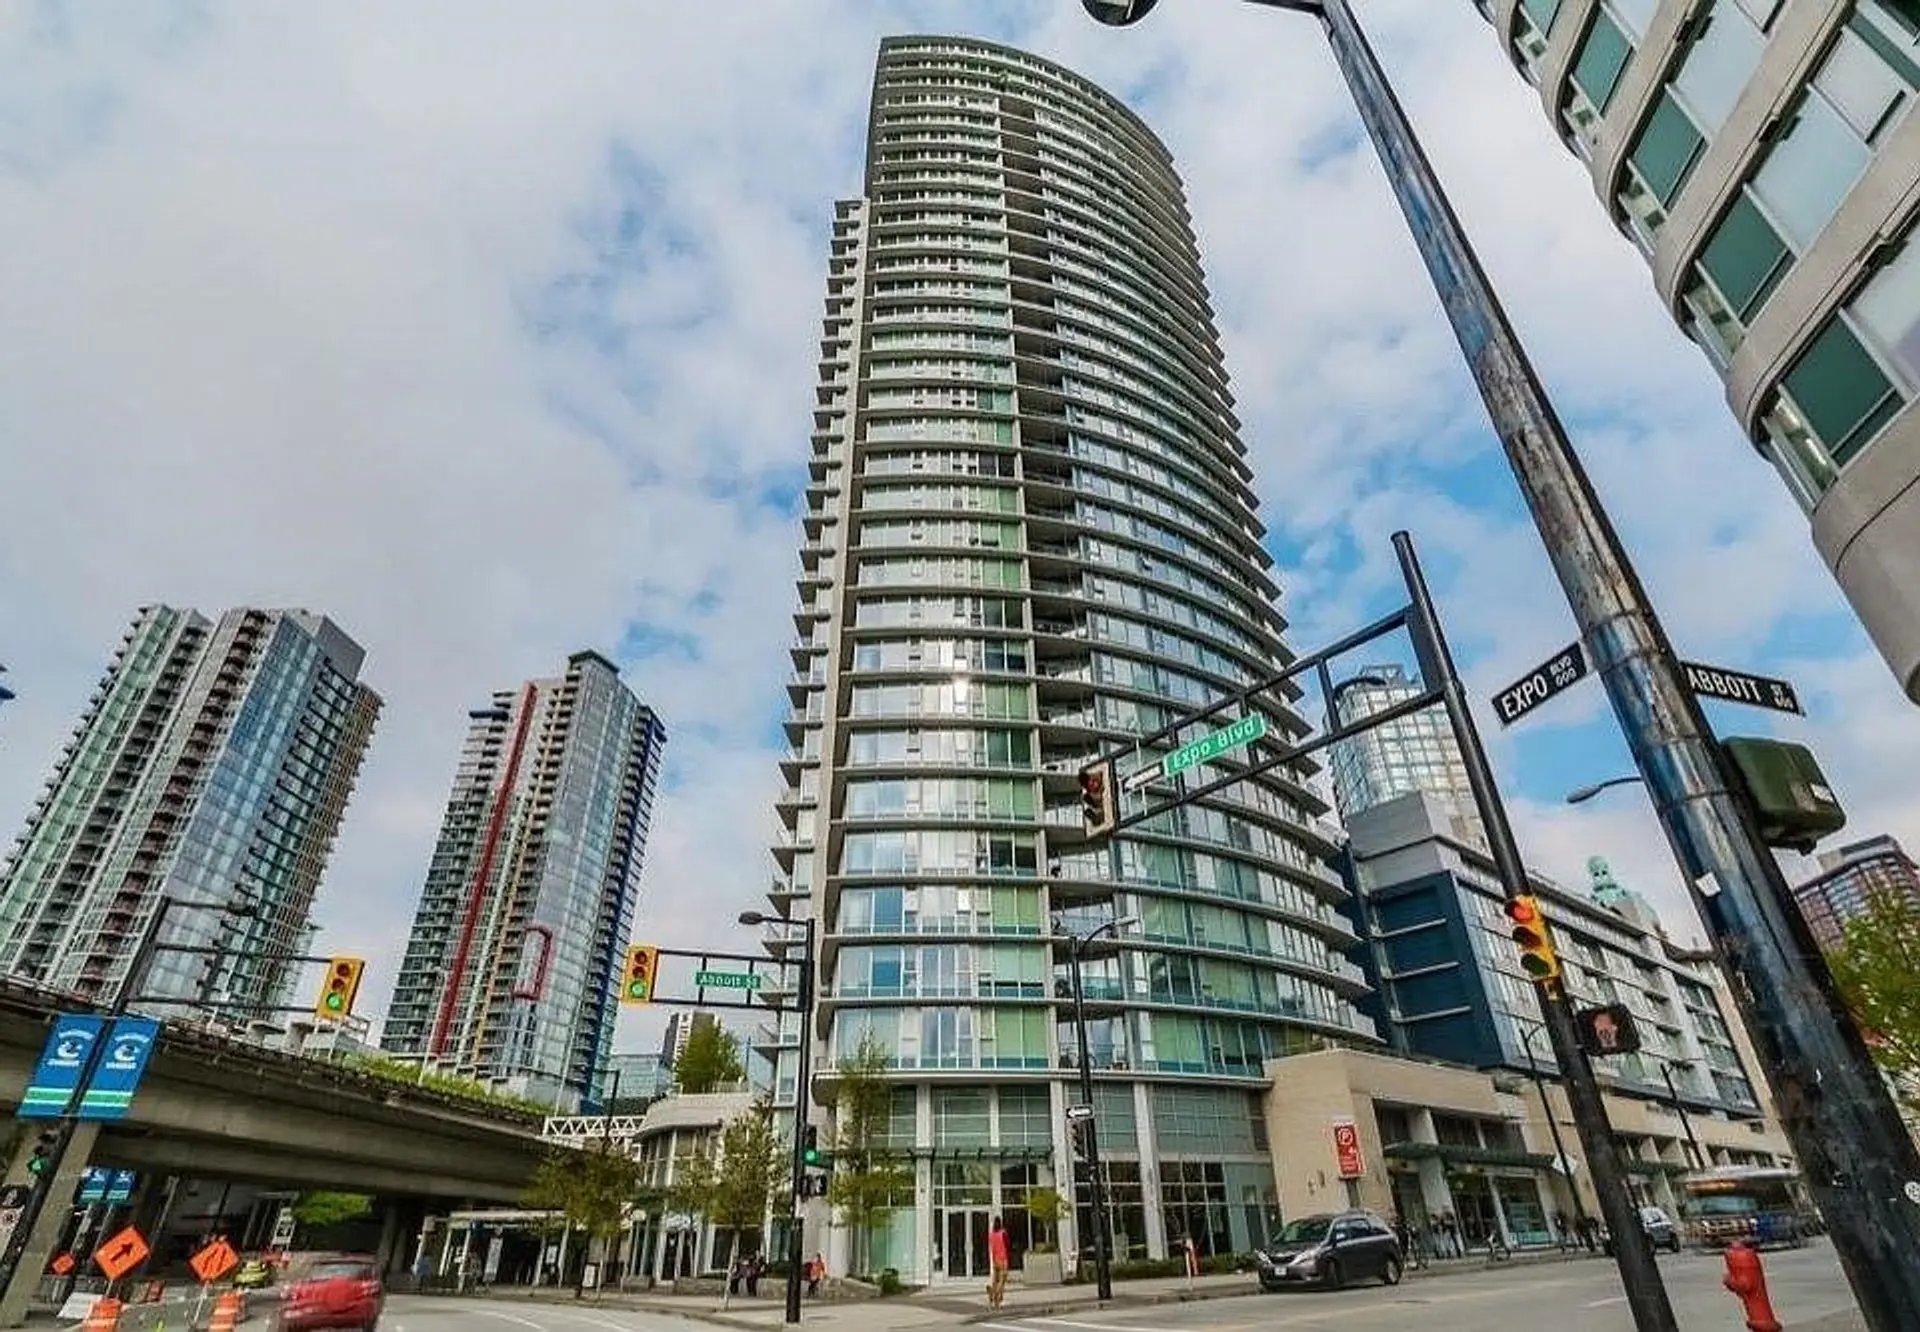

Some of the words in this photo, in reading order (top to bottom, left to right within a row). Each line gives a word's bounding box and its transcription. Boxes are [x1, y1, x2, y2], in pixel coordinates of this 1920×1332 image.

[1501, 673, 1548, 718] EXPO
[1686, 666, 1762, 702] ABBOTT
[1173, 741, 1212, 768] Expo
[1217, 720, 1254, 749] Blvd
